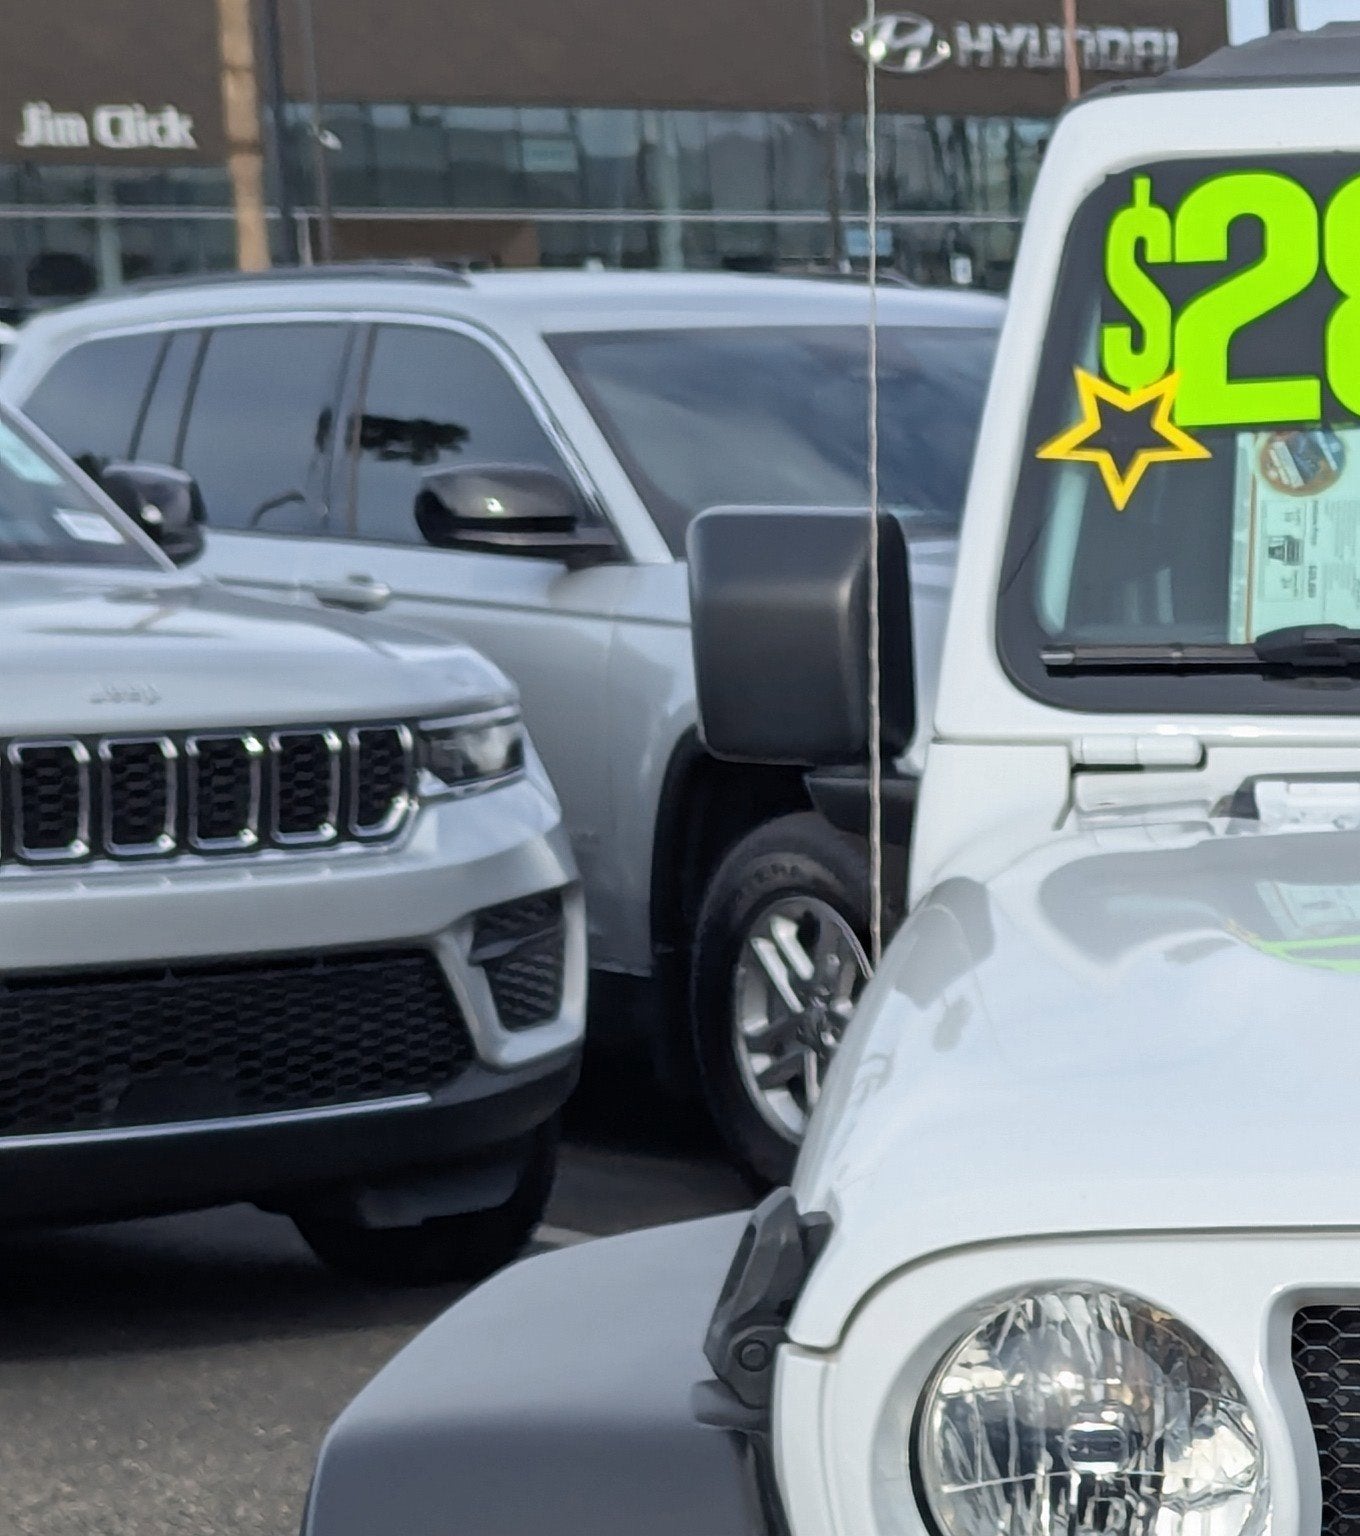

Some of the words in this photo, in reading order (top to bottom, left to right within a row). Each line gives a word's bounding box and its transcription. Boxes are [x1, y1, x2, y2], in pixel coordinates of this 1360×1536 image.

[955, 21, 1179, 71] HYUNDAI
[16, 101, 91, 148] Jim
[92, 102, 199, 150] Click
